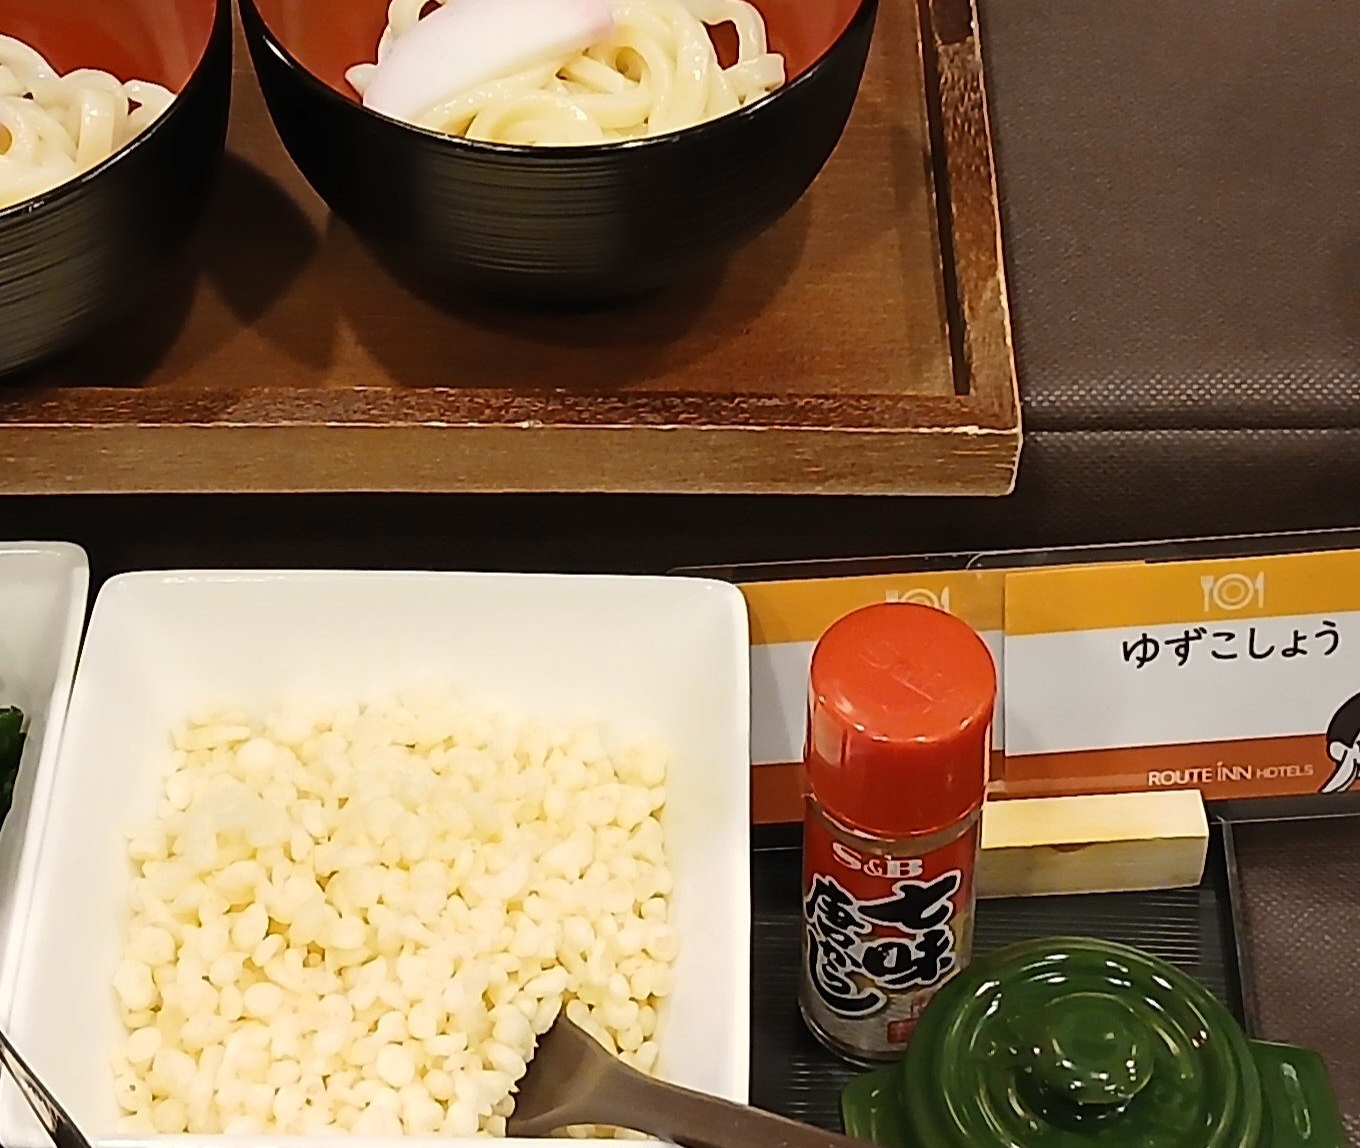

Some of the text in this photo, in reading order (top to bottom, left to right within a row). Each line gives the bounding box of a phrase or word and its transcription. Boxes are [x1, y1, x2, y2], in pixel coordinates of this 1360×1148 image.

[1122, 620, 1339, 669] ゆずこしょう
[1148, 766, 1213, 786] ROUTE
[1256, 764, 1315, 779] HOTELS
[832, 842, 924, 878] S&B
[856, 870, 962, 989] 七味
